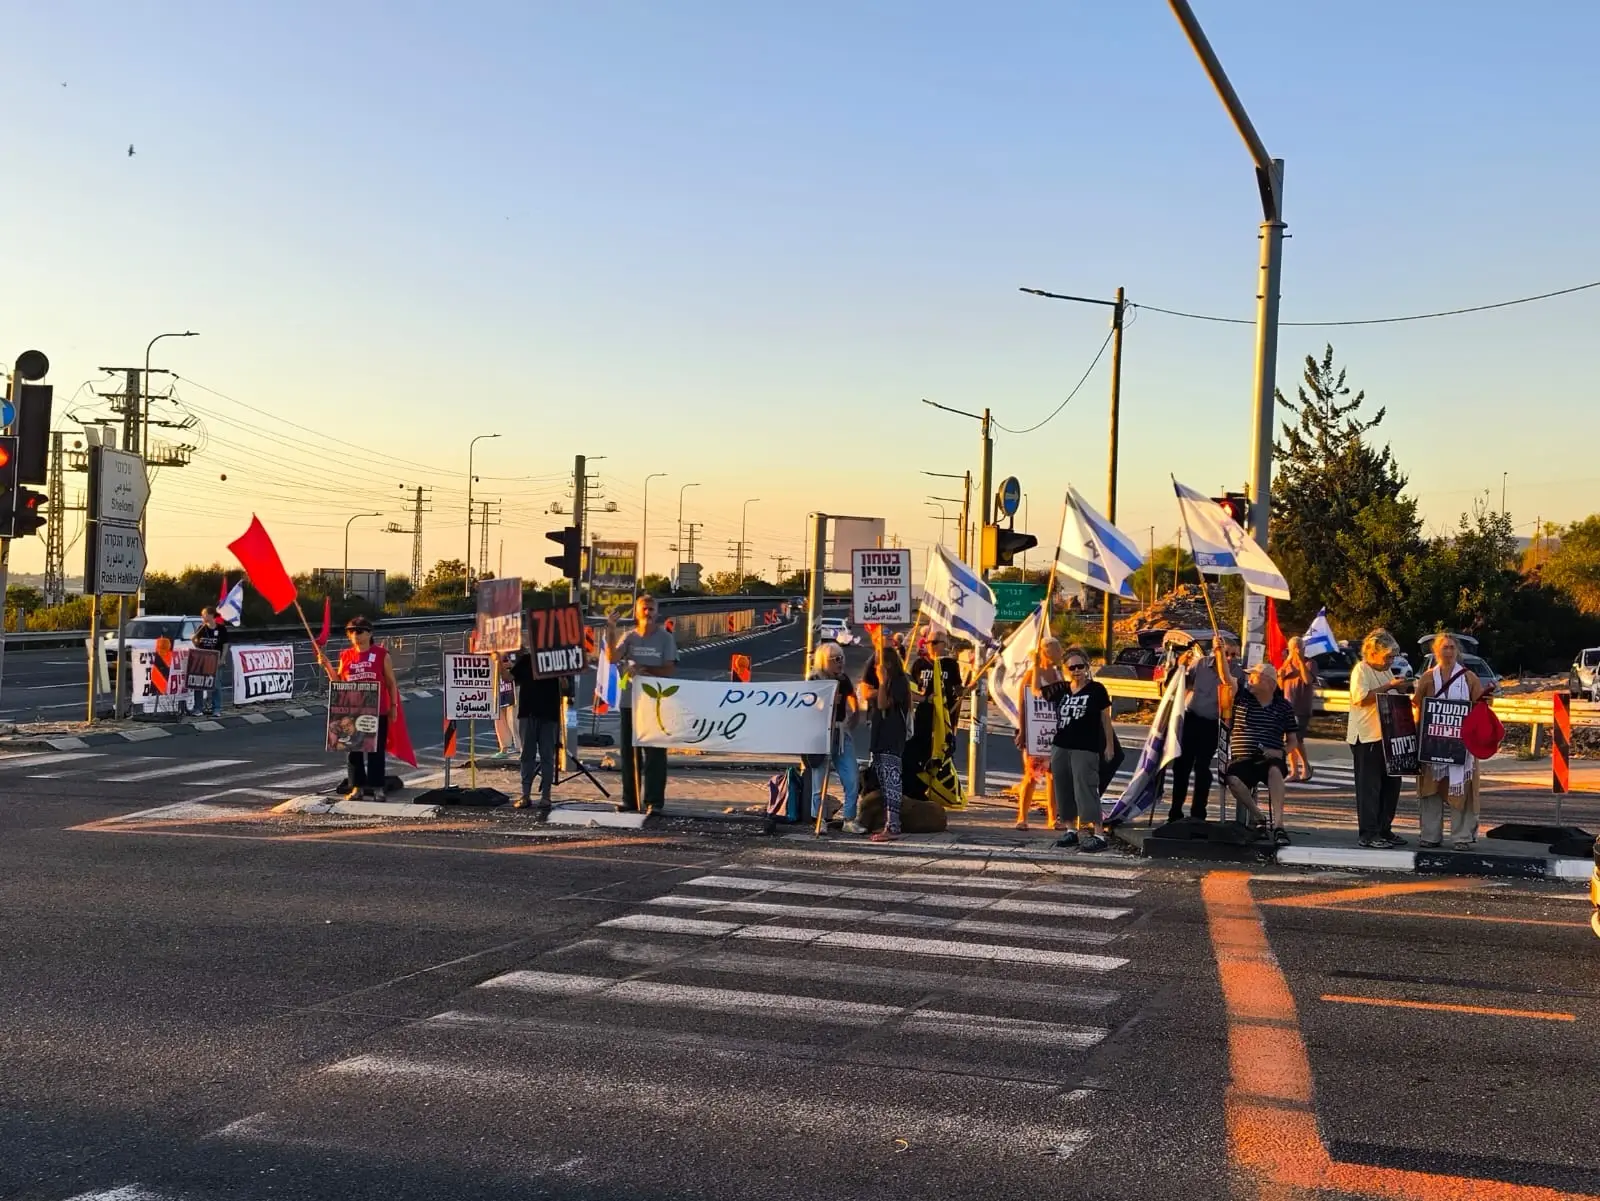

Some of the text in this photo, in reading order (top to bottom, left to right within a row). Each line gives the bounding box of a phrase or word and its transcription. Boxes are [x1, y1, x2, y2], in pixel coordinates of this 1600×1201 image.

[111, 498, 134, 513] Shelomi
[104, 533, 139, 549] ראש הנקרה
[861, 553, 901, 565] בטחון
[101, 571, 139, 585] Rosh HaNikra
[861, 565, 901, 577] שוויון
[864, 602, 901, 615] المساواة
[532, 607, 580, 649] 7/10
[453, 657, 490, 668] בטחון
[537, 645, 584, 673] לא נשכח
[453, 668, 490, 679] שוויון
[719, 689, 817, 709] בוחרים
[456, 702, 490, 714] المساواة
[1427, 701, 1468, 717] ממשלת
[1432, 713, 1462, 727] הטבח
[683, 712, 747, 744] שינוי
